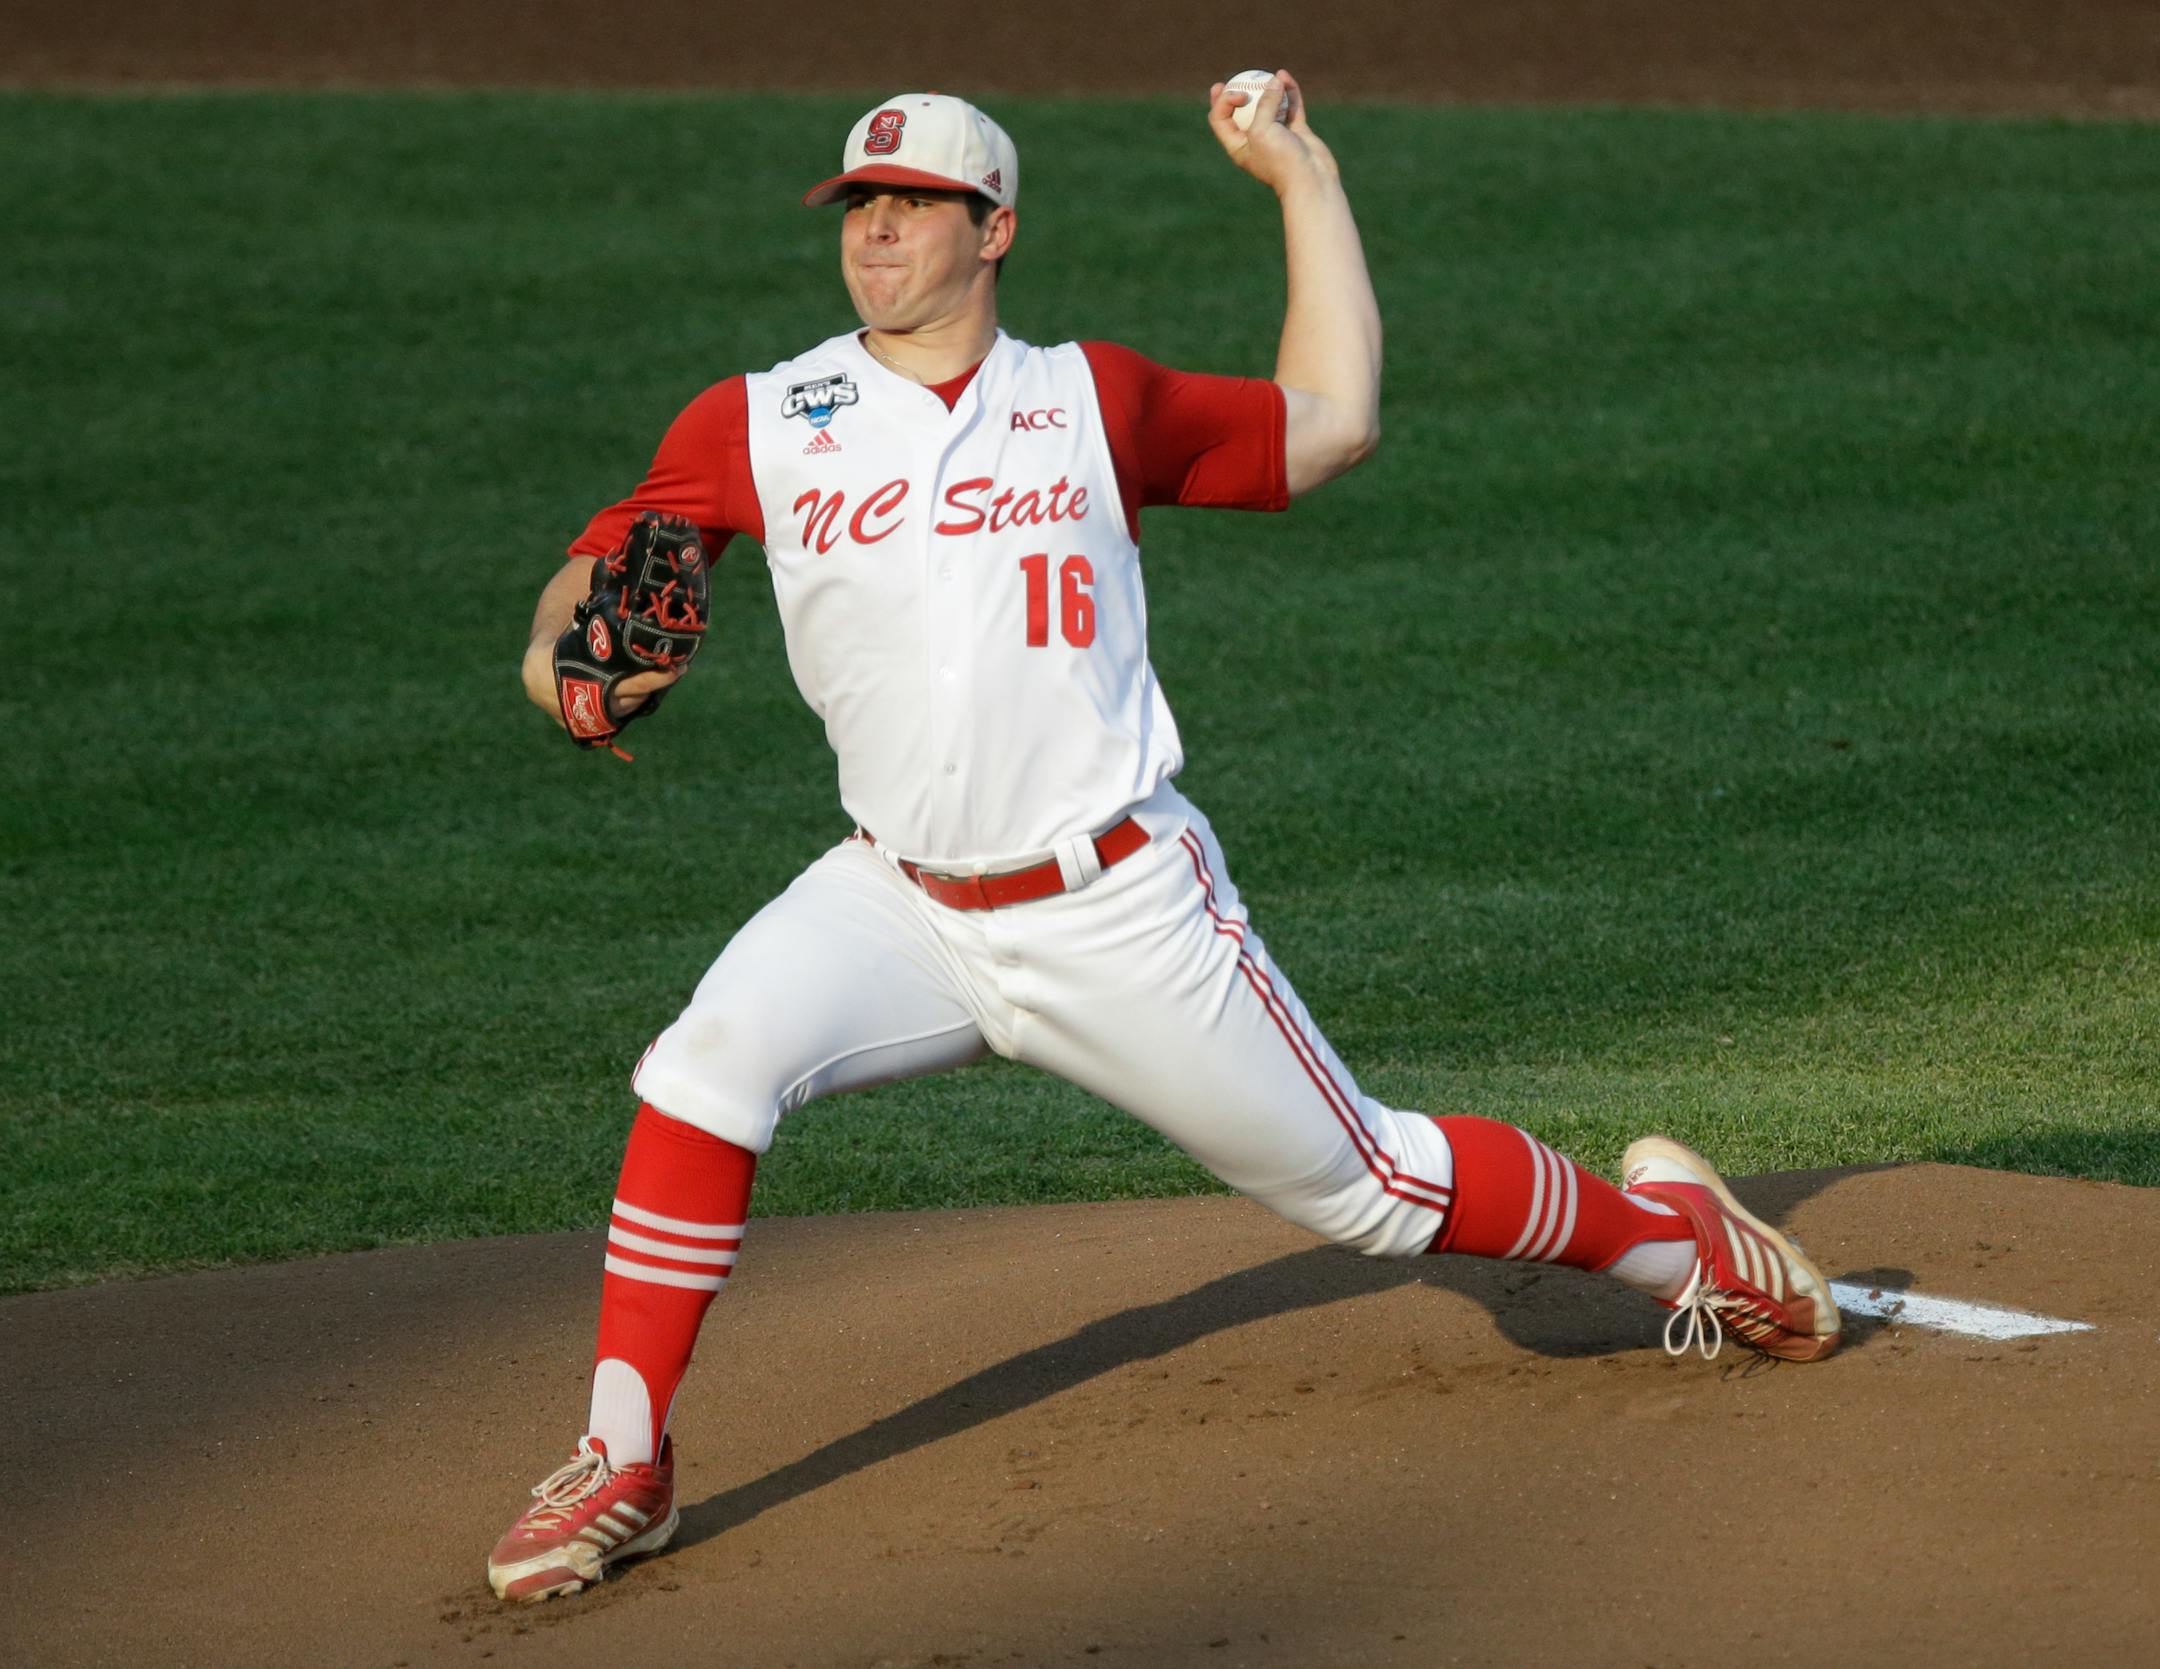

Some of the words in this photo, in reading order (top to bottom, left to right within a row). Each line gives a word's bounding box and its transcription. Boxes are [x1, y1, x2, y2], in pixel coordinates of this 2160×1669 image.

[781, 382, 859, 419] CWS
[1010, 407, 1067, 432] ACC
[803, 443, 842, 455] adidas
[793, 478, 909, 555] NC
[934, 475, 1089, 536] State
[1019, 553, 1096, 649] 16
